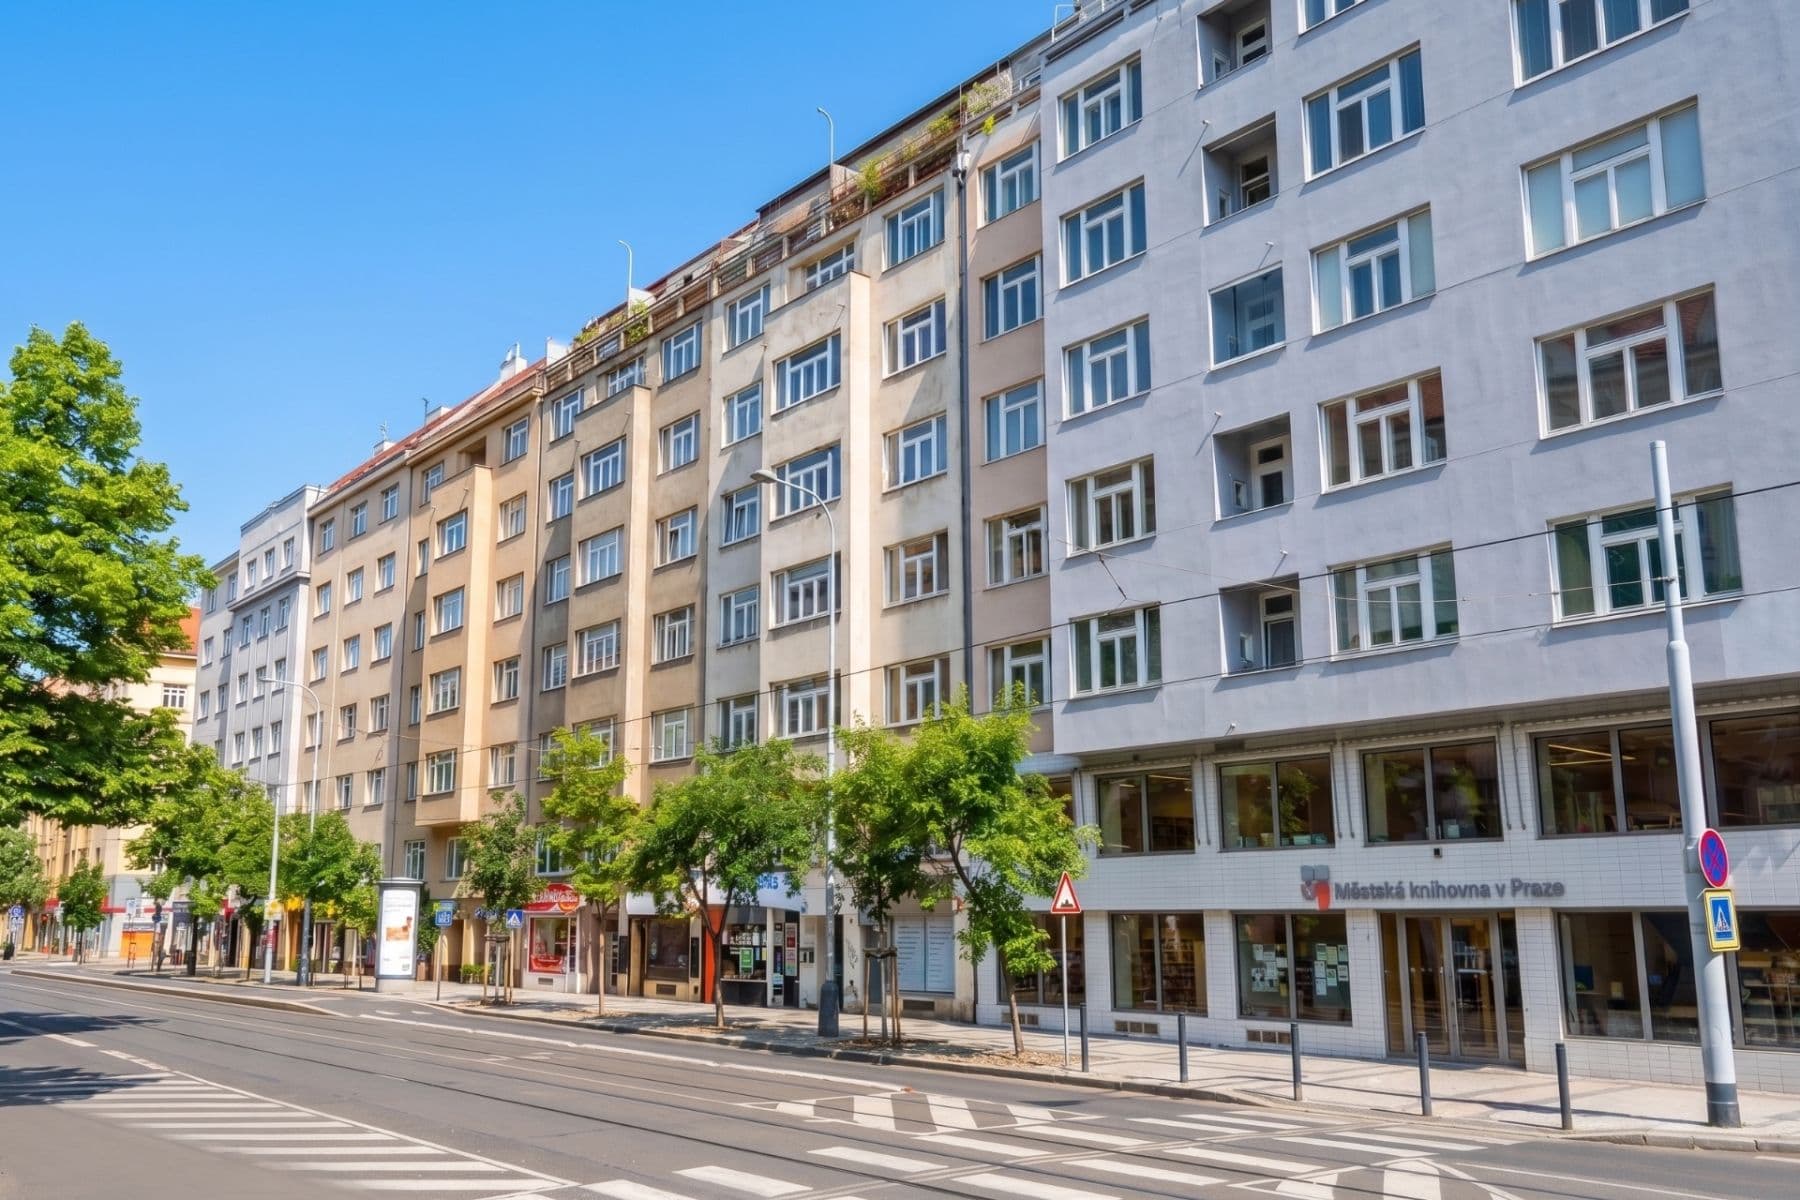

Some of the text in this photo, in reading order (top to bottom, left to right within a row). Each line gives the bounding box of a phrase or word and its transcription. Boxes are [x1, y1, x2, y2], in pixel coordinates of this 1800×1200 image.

[1335, 878, 1565, 900] Městská knihovna v Praze
